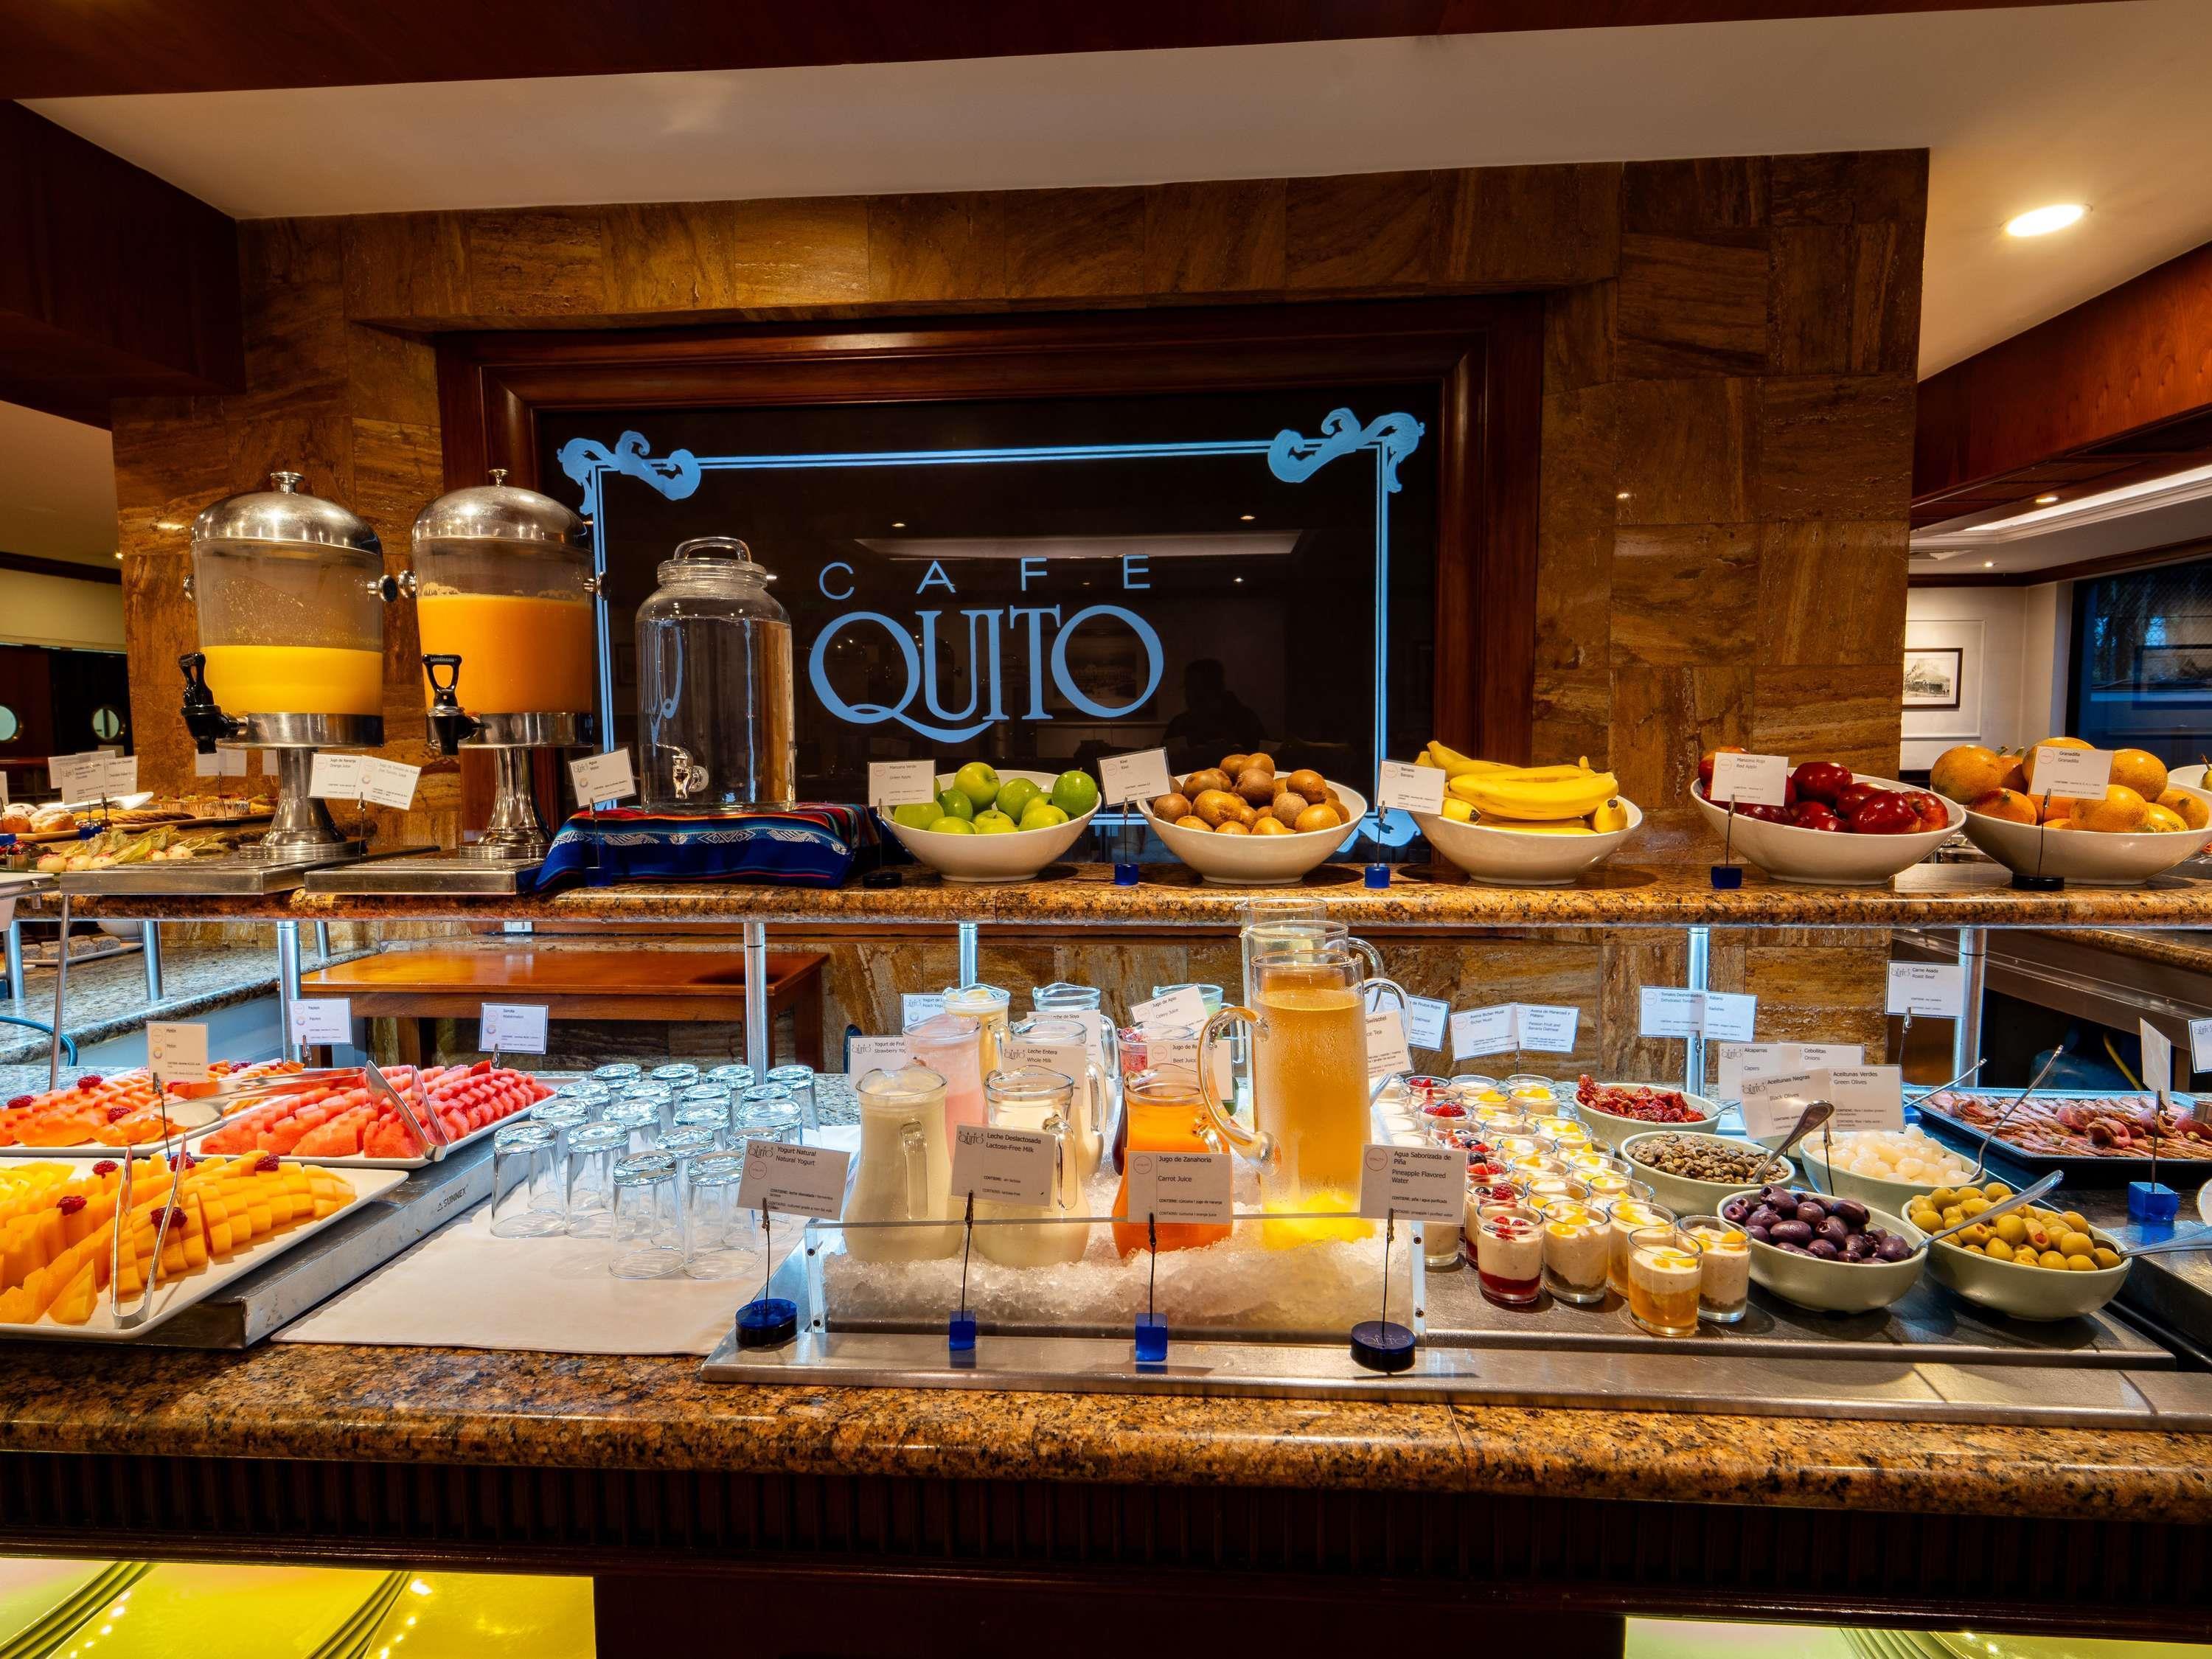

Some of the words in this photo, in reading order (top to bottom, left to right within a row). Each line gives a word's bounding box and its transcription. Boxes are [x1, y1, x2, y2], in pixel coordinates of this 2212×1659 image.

[809, 605, 1164, 743] QUITO
[1005, 1135, 1041, 1144] Deslactosada
[777, 1146, 795, 1155] Yogurt
[796, 1149, 817, 1157] Natural
[986, 1143, 1022, 1152] Lactose-Free
[1411, 1152, 1442, 1160] Saborizada
[442, 1187, 467, 1208] SUNNEX
